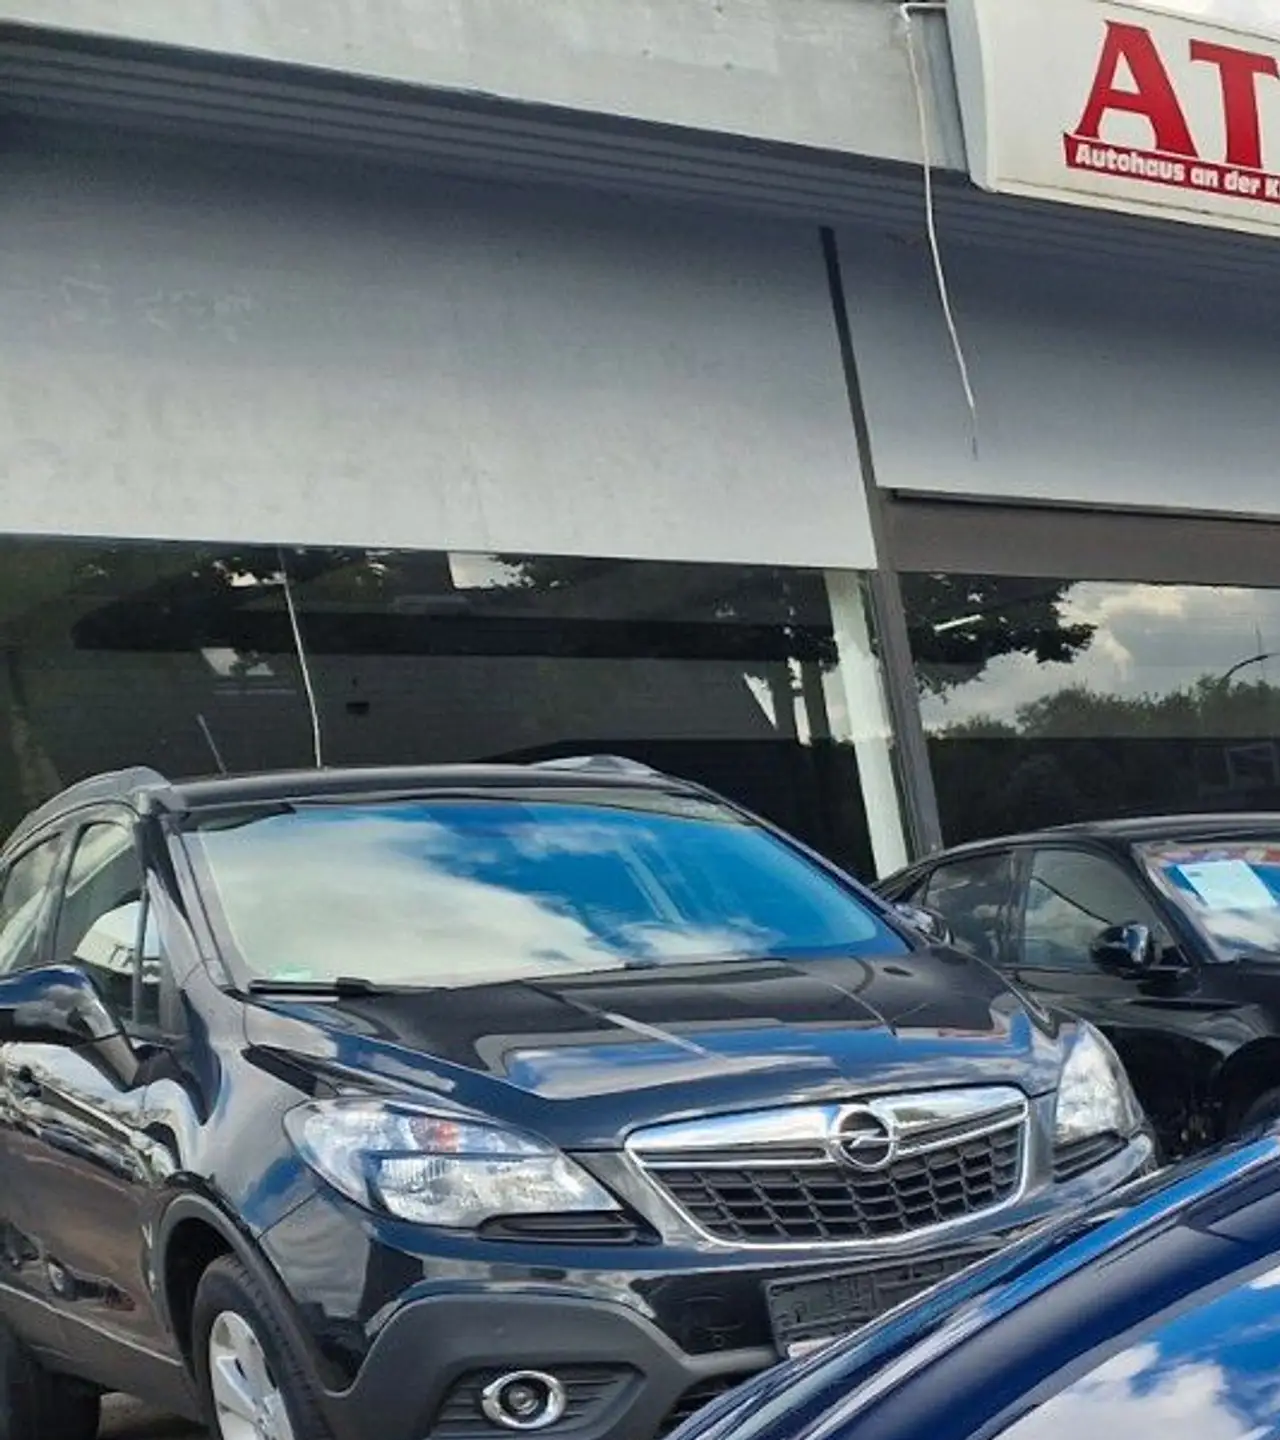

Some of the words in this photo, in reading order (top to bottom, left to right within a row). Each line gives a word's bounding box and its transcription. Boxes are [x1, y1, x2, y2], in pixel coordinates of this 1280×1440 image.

[1074, 142, 1185, 183] Autohaus
[1190, 164, 1219, 188] an
[1223, 168, 1261, 196] der
